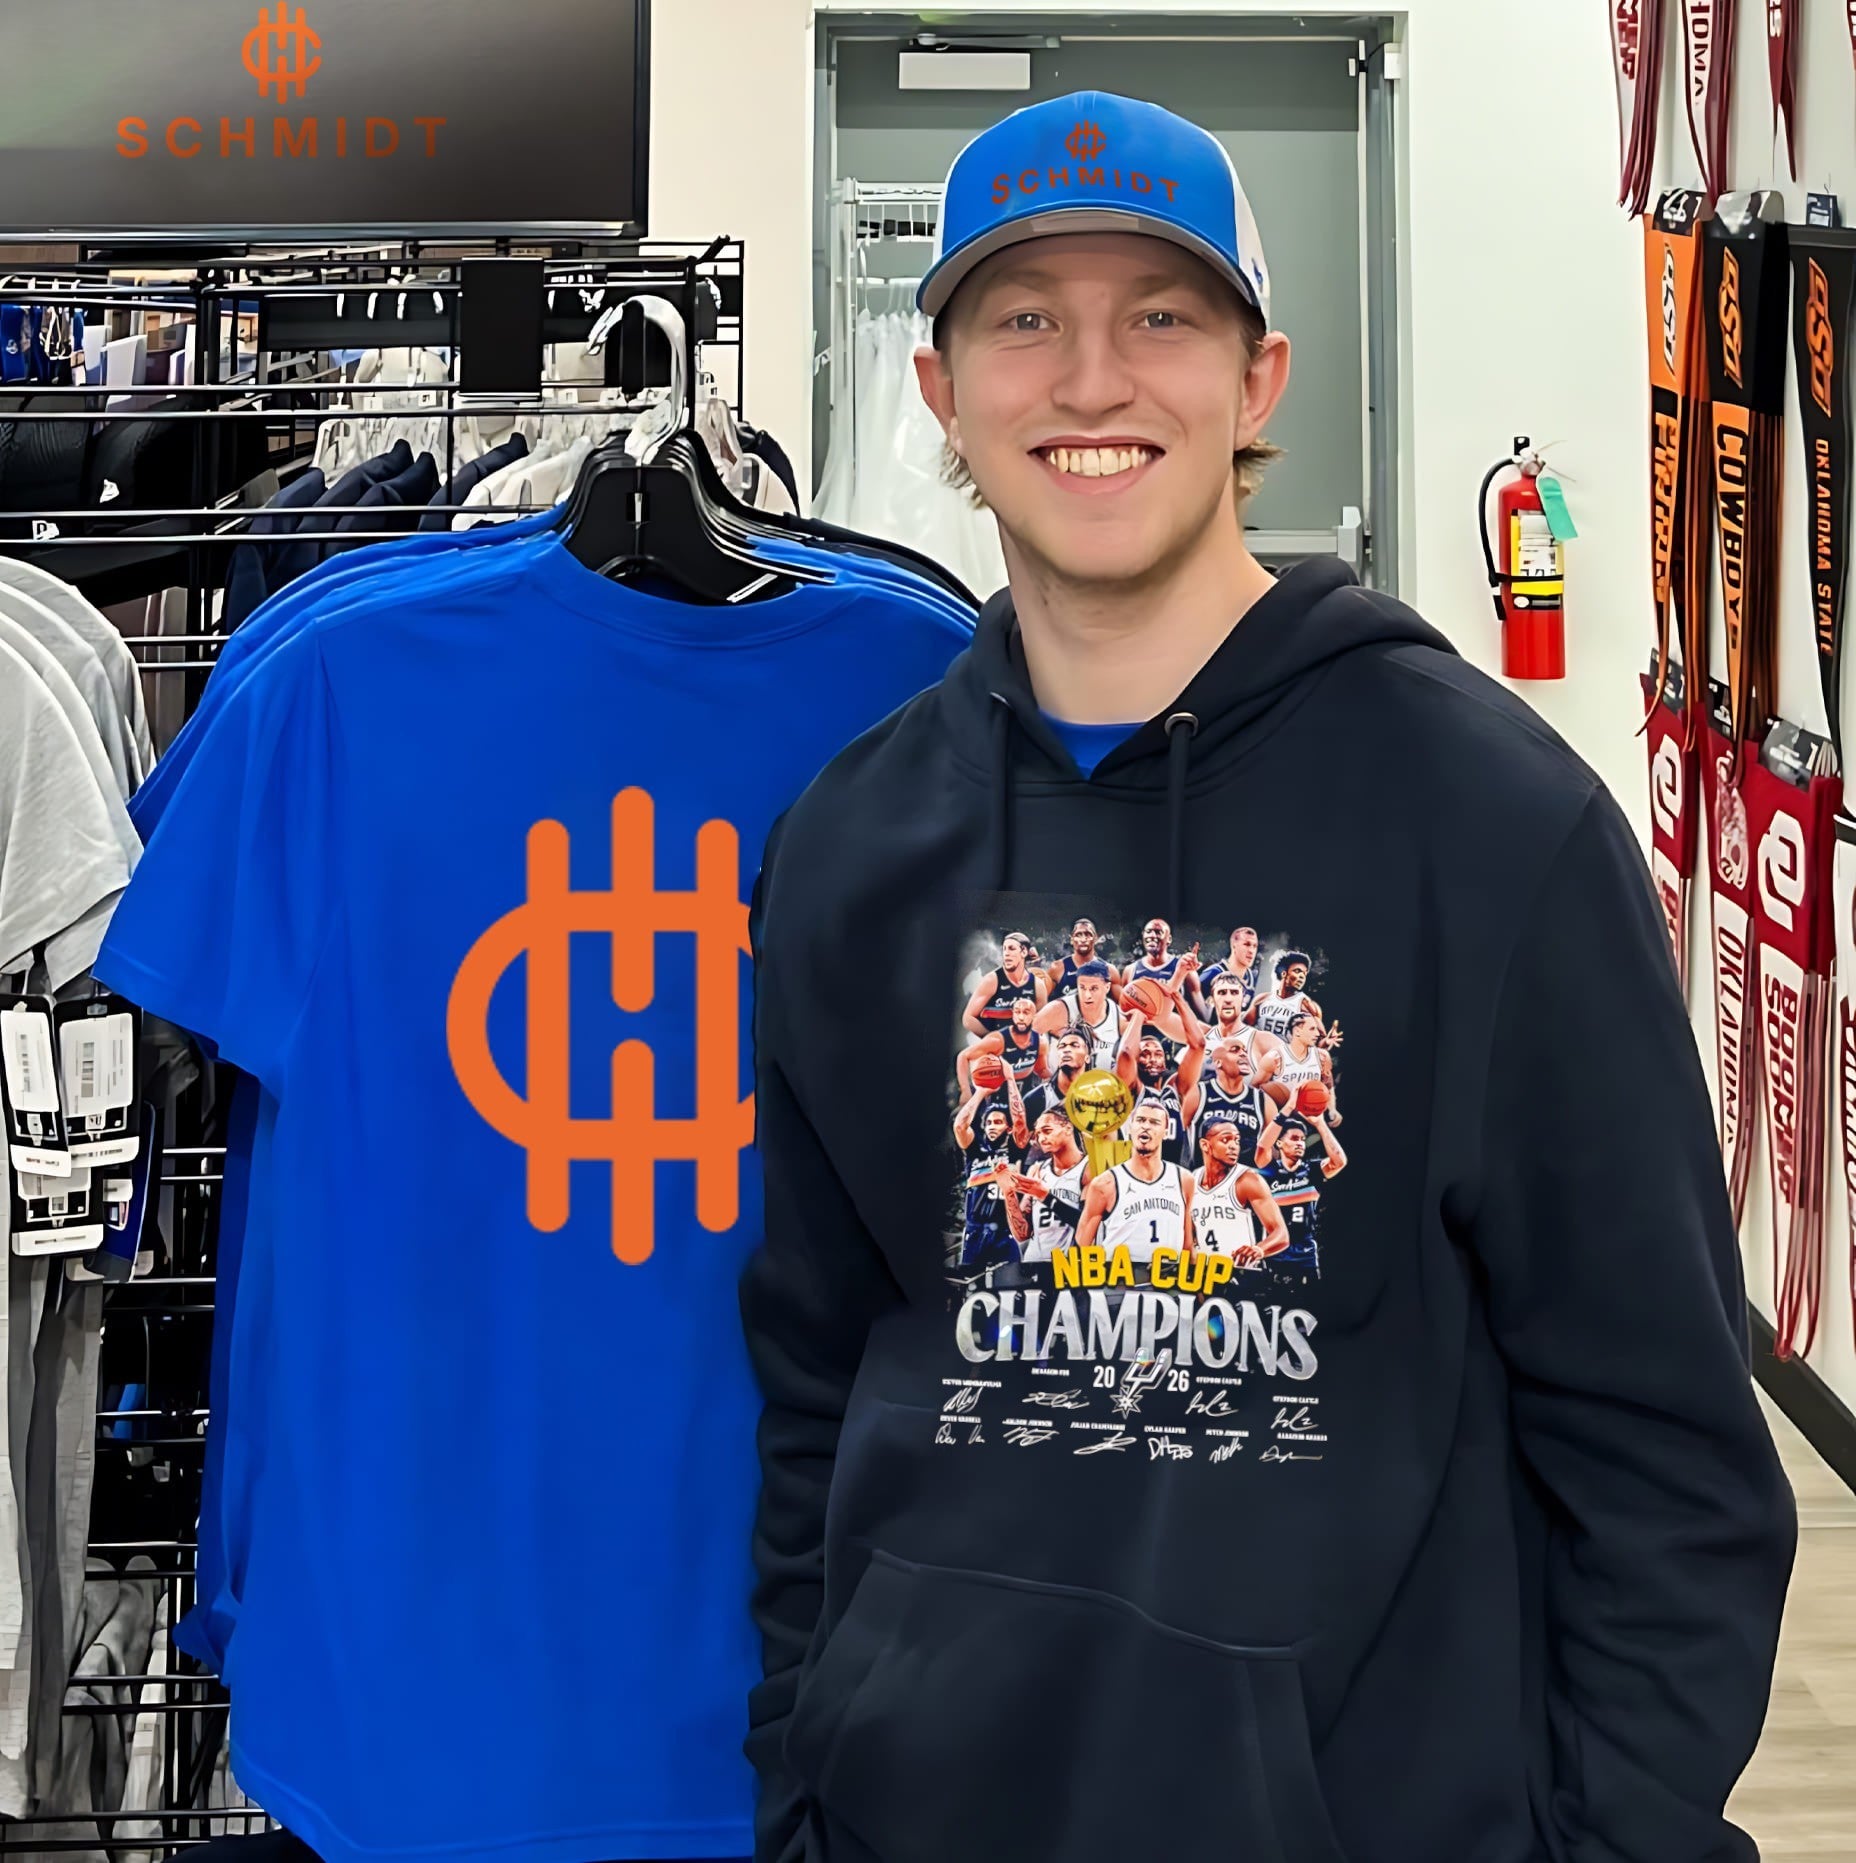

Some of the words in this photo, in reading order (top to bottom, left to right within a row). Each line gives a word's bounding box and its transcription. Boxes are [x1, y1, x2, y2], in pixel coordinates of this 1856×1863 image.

[115, 117, 447, 158] SCHMIDT
[991, 167, 1179, 205] SCHMIDT
[1815, 438, 1832, 570] OKLAHOMA
[1817, 583, 1833, 656] STATE
[1718, 925, 1745, 1144] OKLAHOMA
[1123, 1201, 1141, 1220] SAN
[1192, 1205, 1236, 1226] PURS
[1149, 1220, 1160, 1243] 1
[1205, 1229, 1219, 1252] 4
[1052, 1244, 1135, 1290] NBA
[1150, 1246, 1234, 1295] CUP
[955, 1289, 1319, 1380] CHAMPIONS
[1093, 1366, 1115, 1388] 20
[1167, 1369, 1190, 1392] 26
